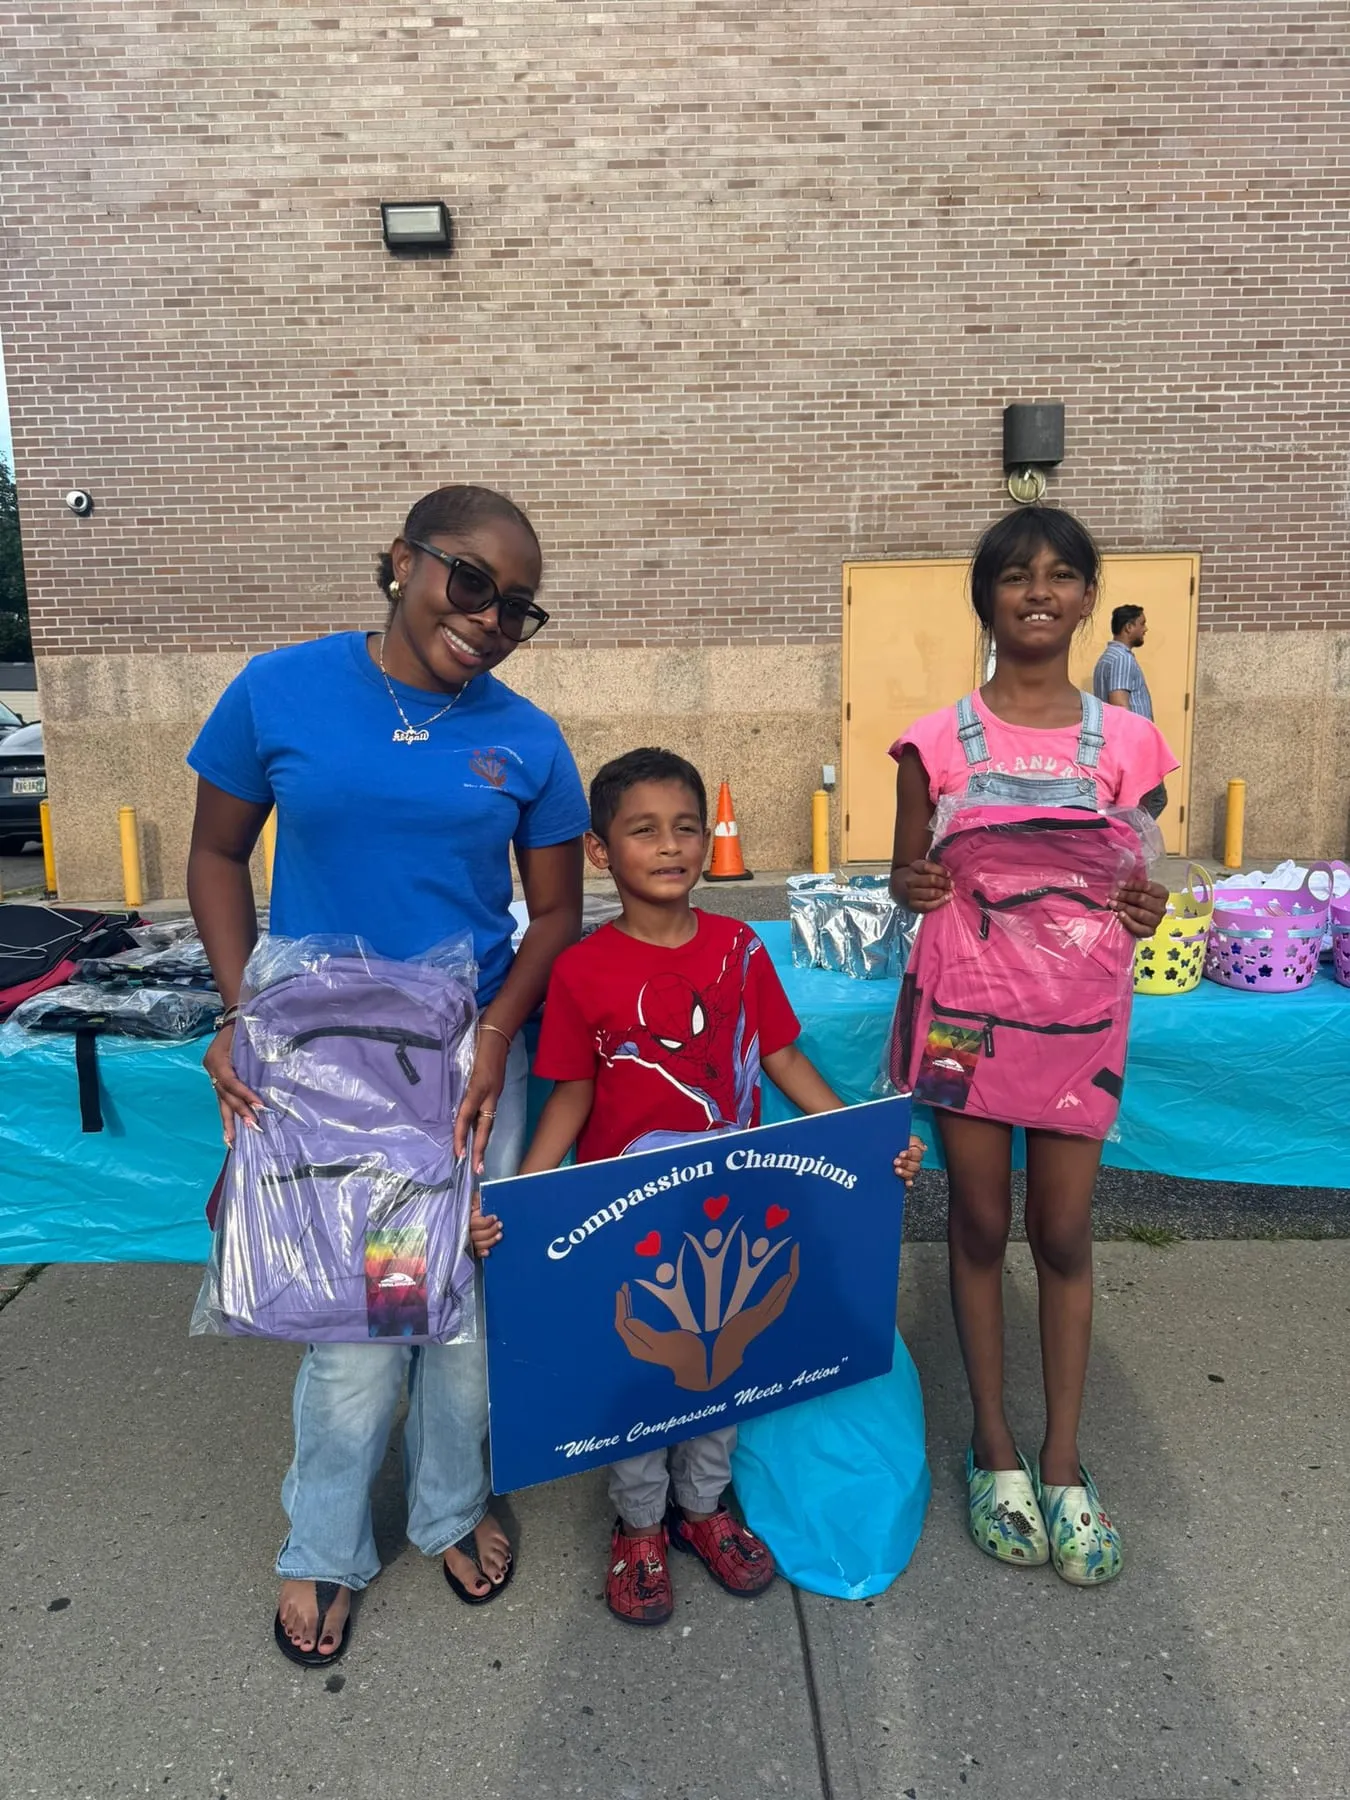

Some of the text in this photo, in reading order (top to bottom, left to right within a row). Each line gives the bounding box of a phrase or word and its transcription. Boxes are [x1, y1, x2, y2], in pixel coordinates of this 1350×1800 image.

[1014, 755, 1057, 772] AND
[547, 1149, 858, 1260] Compassion Champions
[626, 1402, 727, 1443] Compassion
[734, 1383, 784, 1406] Meets
